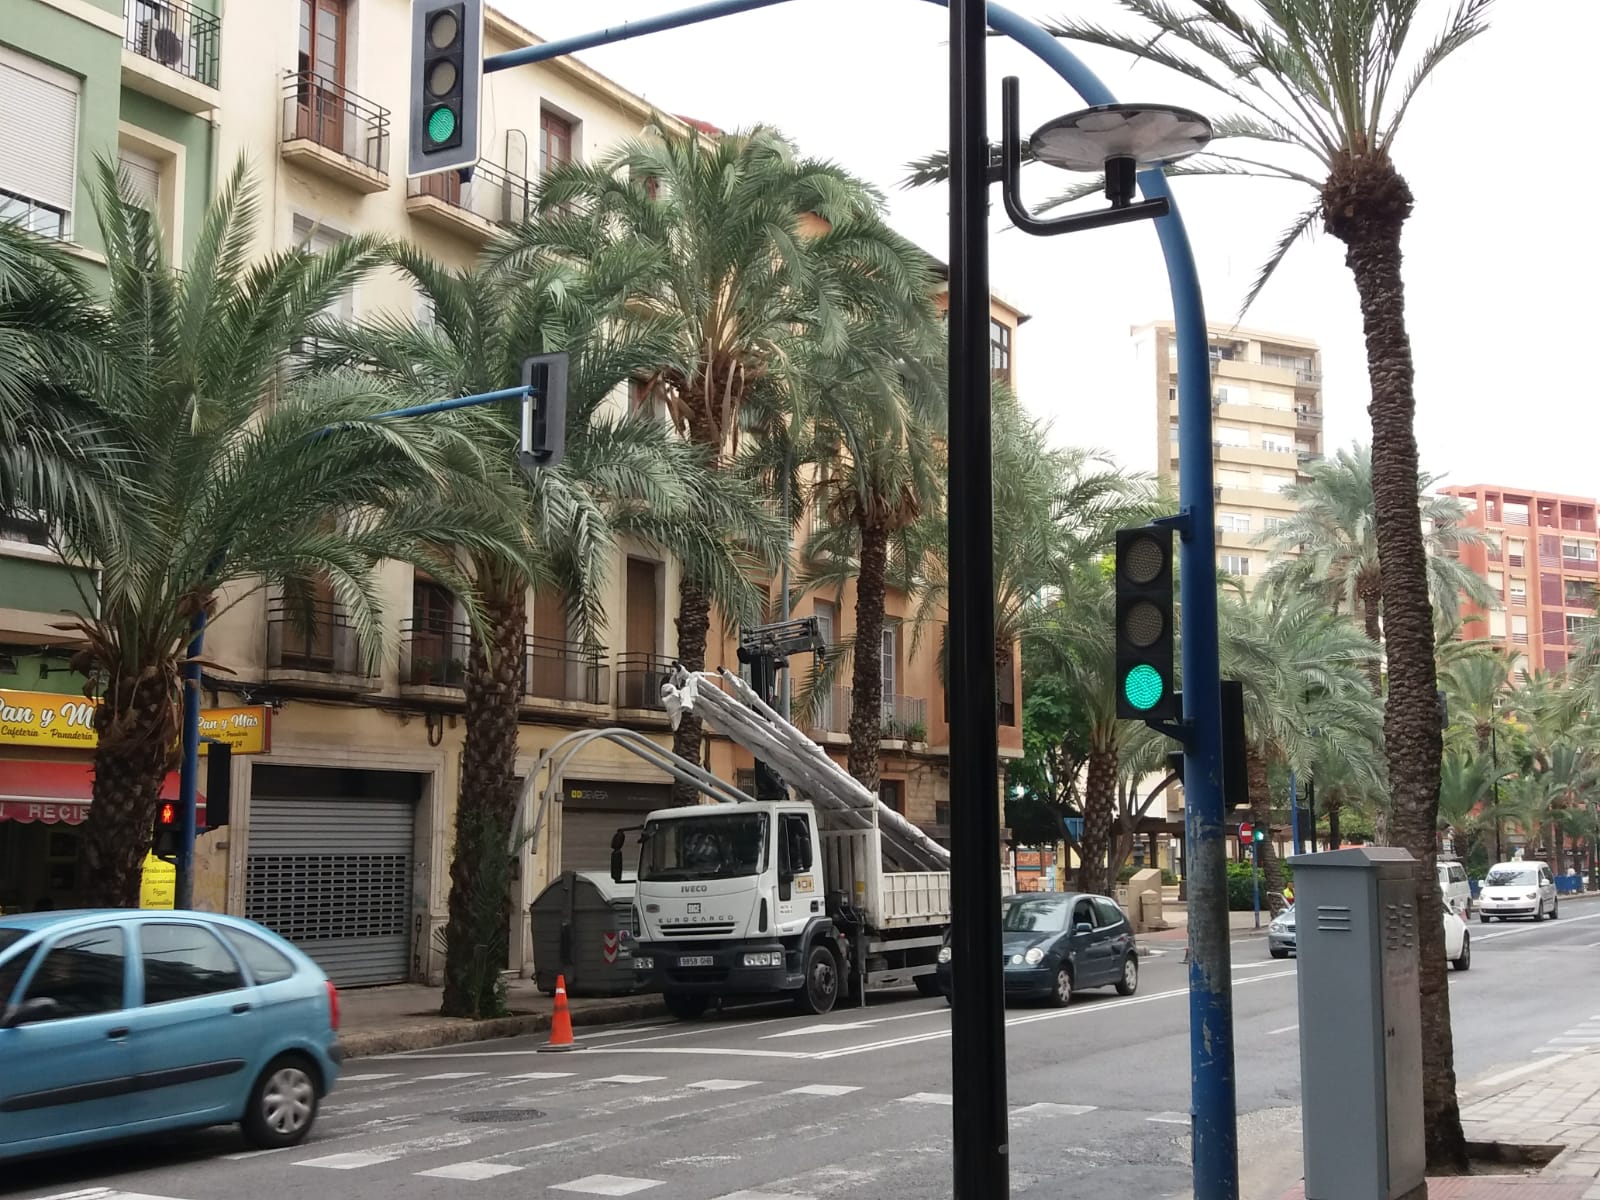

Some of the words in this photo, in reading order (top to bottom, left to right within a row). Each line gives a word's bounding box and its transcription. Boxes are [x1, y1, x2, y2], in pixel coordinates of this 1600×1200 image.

[40, 708, 56, 728] y
[60, 702, 94, 730] M
[28, 803, 91, 820] RECIE
[681, 885, 708, 893] IVECO
[658, 914, 735, 924] EUROCARGO
